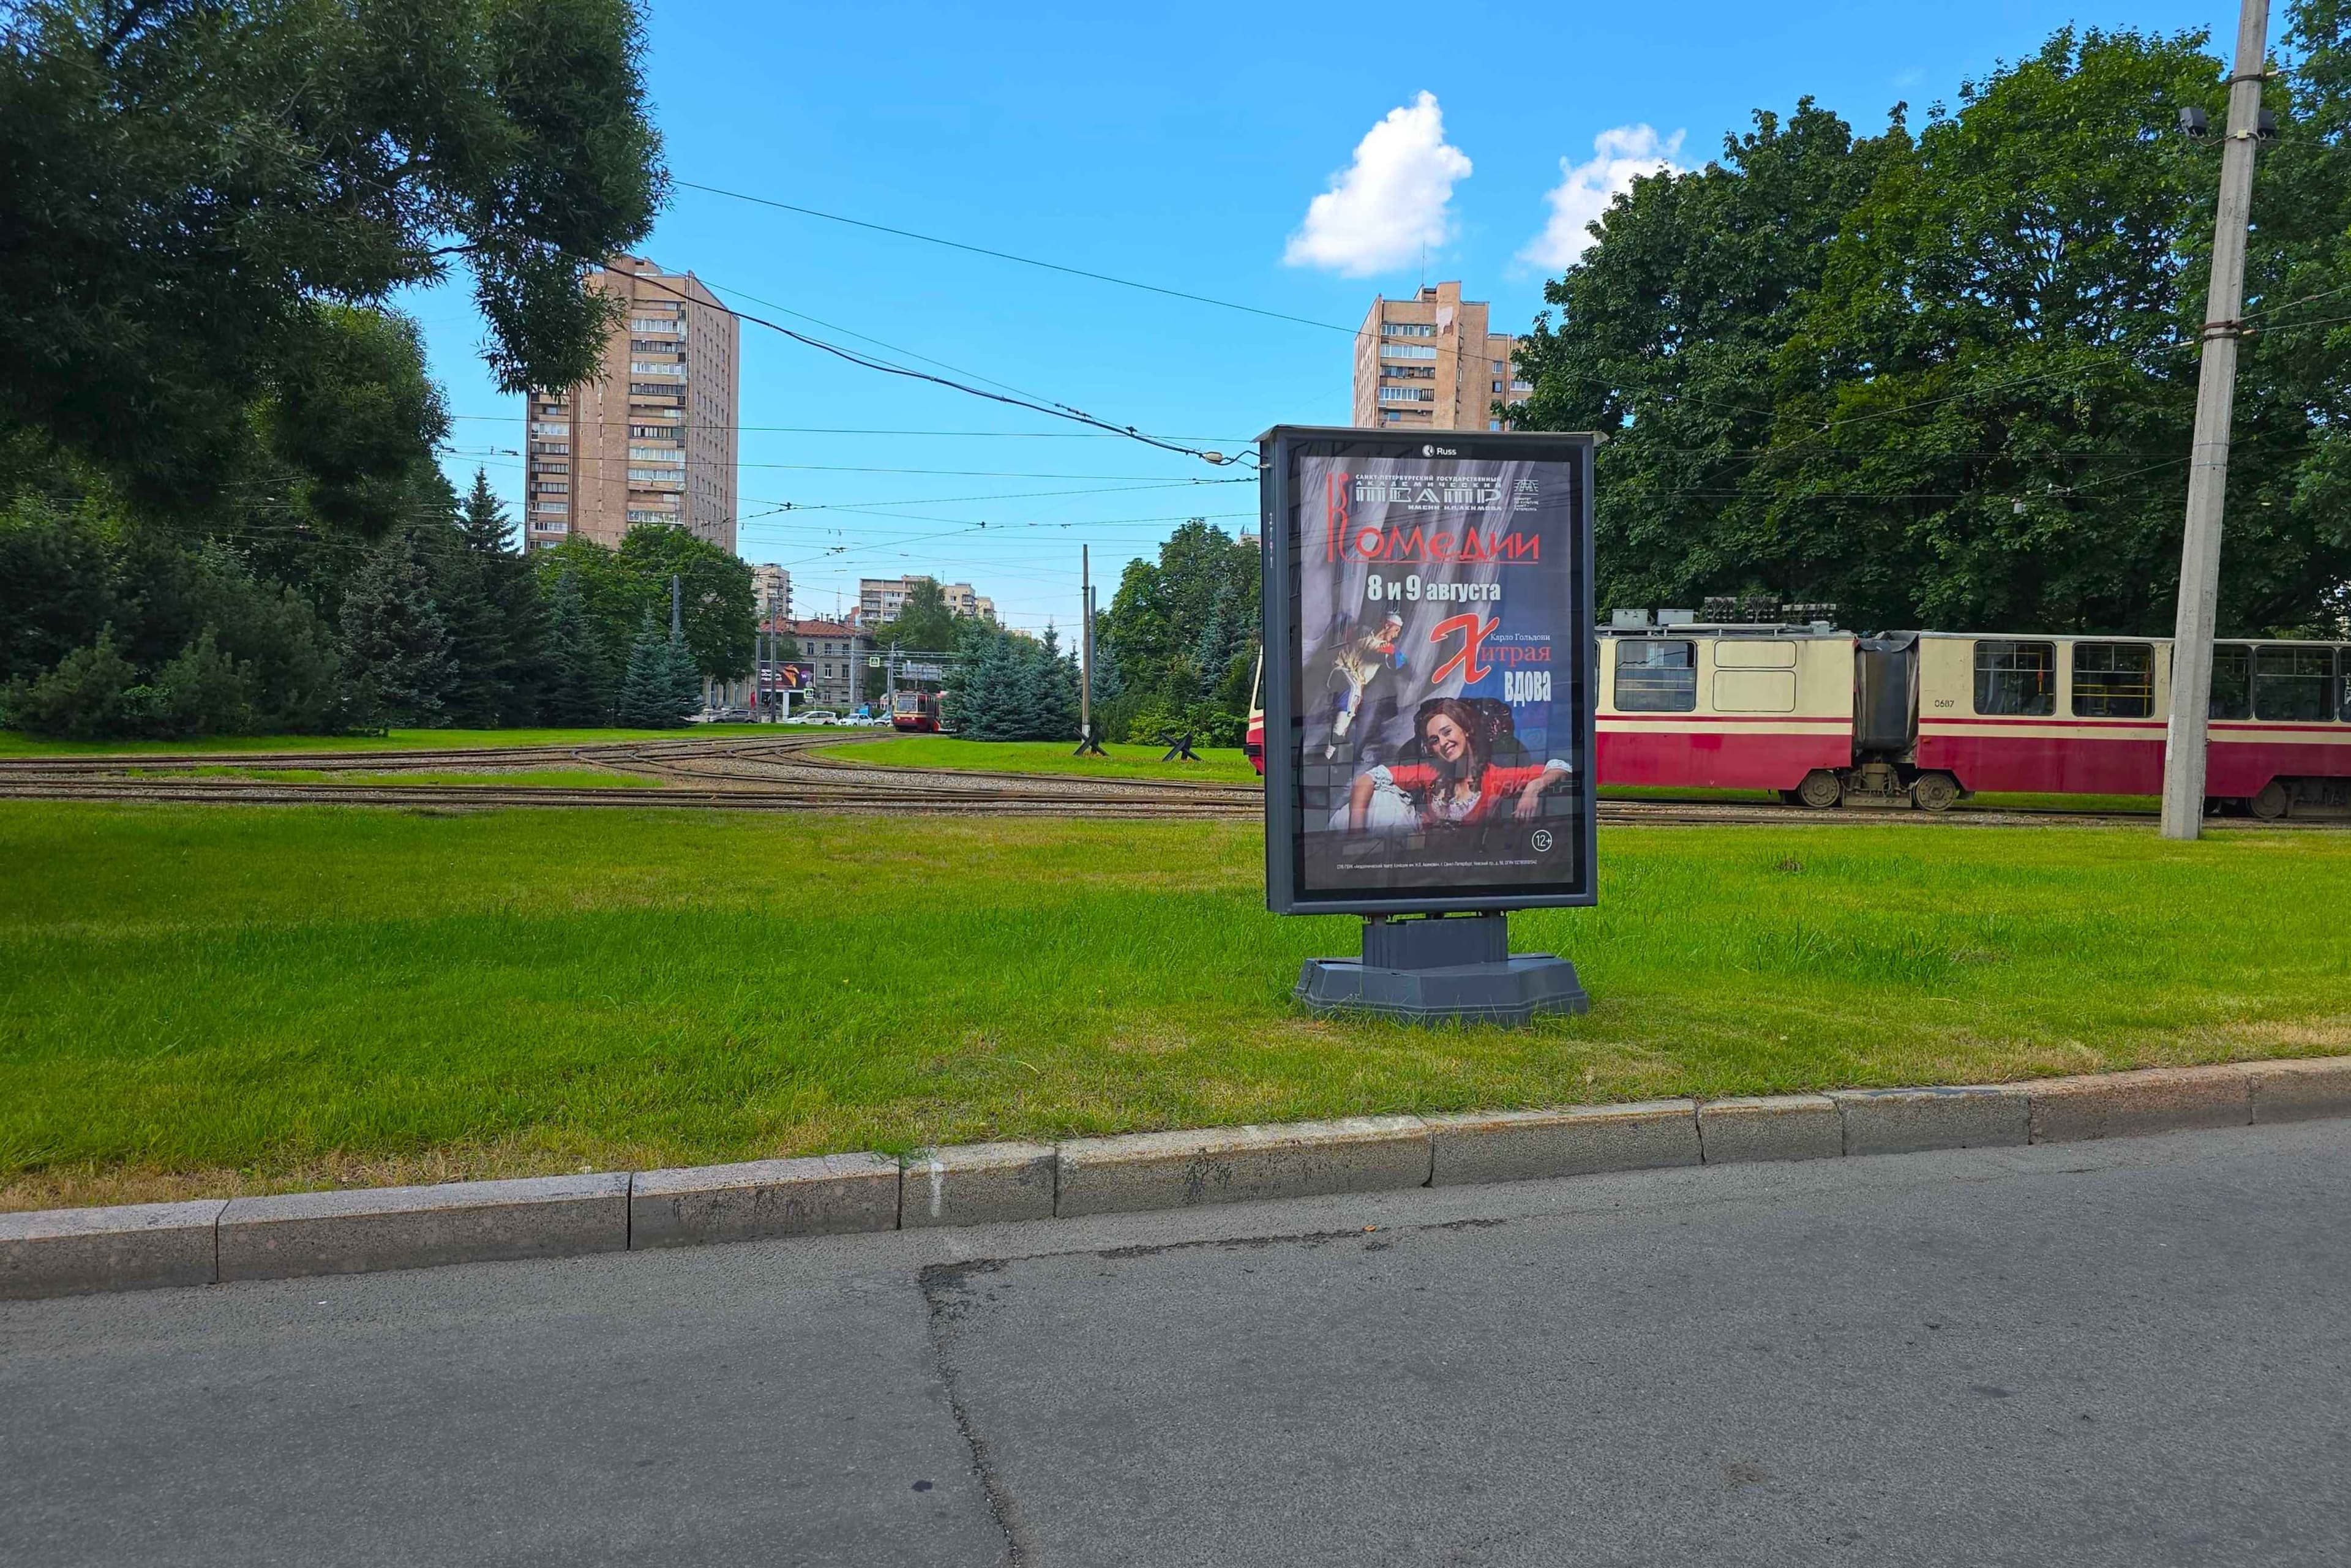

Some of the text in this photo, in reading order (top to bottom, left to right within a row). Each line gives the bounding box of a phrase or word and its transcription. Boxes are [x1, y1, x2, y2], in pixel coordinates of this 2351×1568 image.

[1436, 447, 1457, 456] Russ
[1355, 487, 1501, 503] ТЕАТР
[1368, 574, 1501, 602] 8 и 9 августа
[1490, 633, 1513, 642] Карло
[1430, 613, 1551, 684] Хитрая
[1536, 835, 1551, 846] 12+
